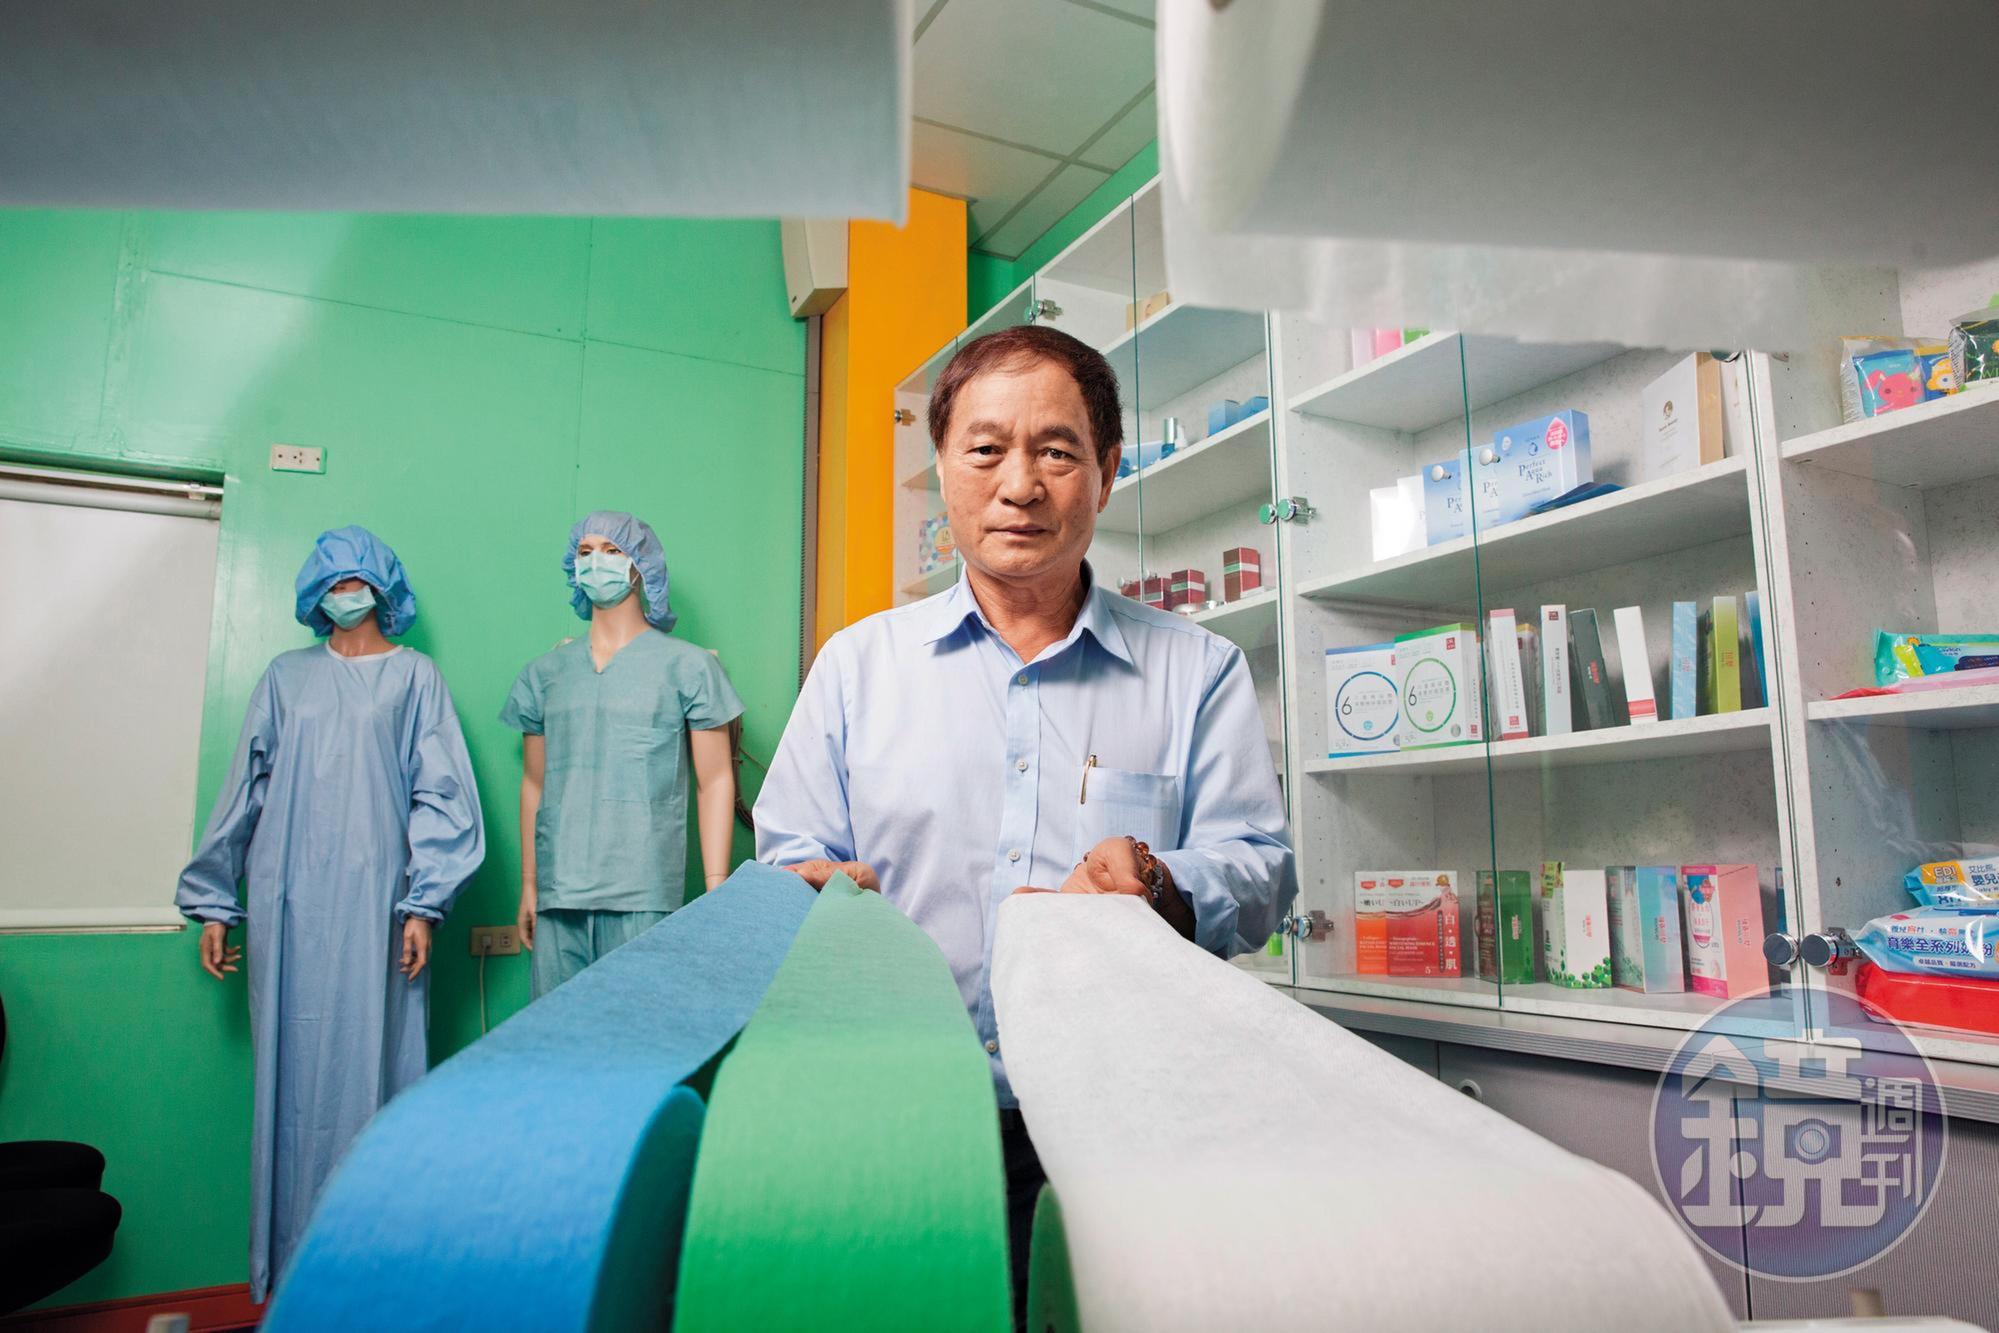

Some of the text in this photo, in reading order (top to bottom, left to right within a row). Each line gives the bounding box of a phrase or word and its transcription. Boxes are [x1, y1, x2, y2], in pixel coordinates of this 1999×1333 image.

[1519, 460, 1546, 477] Perfect
[1536, 472, 1553, 484] Rich
[1971, 873, 1999, 886] 嬰兒
